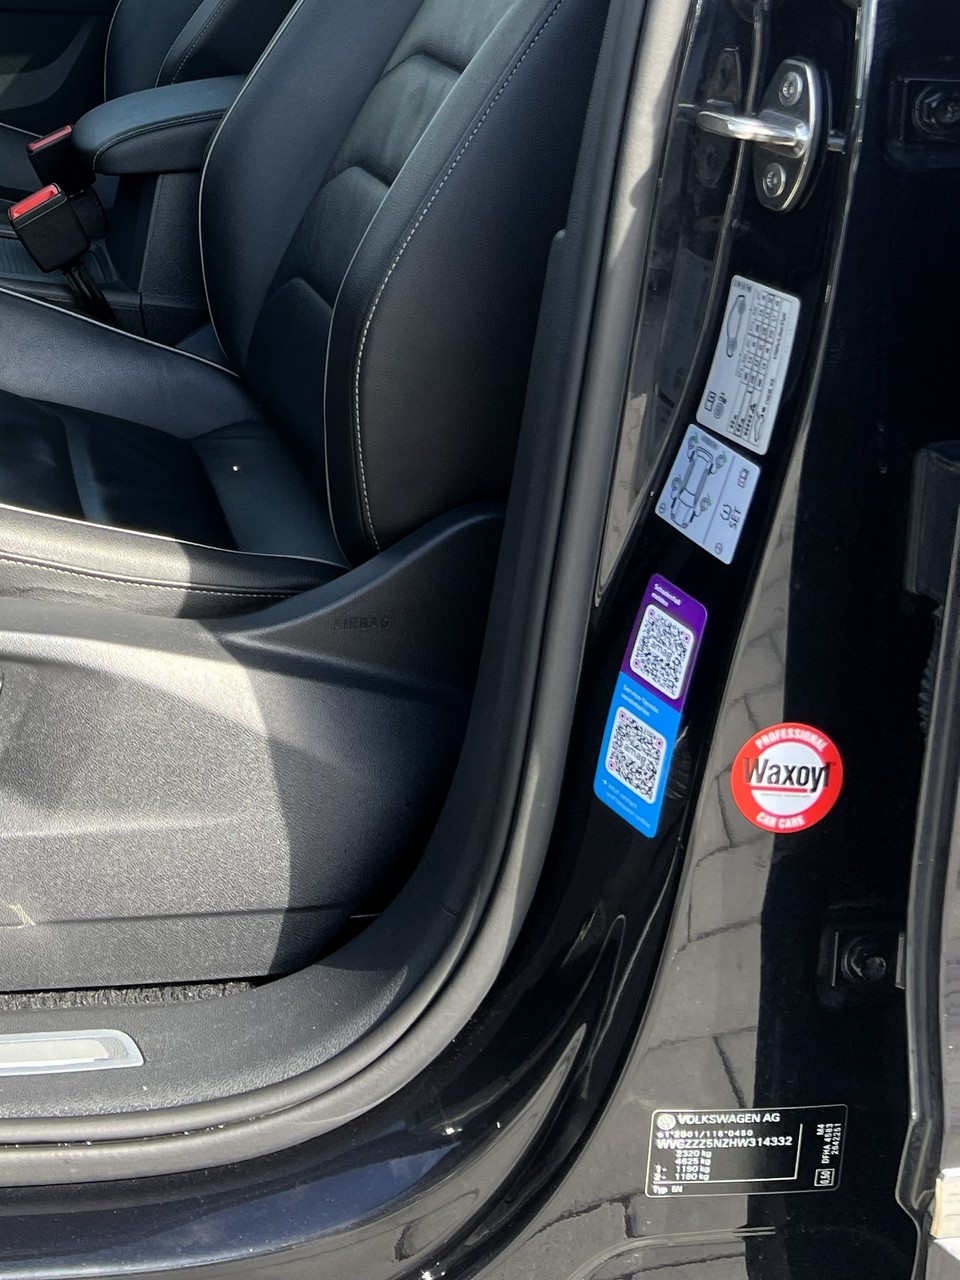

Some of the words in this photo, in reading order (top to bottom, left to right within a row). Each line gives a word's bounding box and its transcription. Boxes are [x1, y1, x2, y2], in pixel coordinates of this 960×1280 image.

[754, 727, 828, 753] PROFESSIONAL
[756, 811, 778, 828] CAR
[778, 815, 806, 829] CARE
[677, 1113, 760, 1125] VOLKSWAGEN
[762, 1112, 781, 1123] AG
[656, 1136, 793, 1149] WVGZZZ5NZHW314332
[701, 1150, 712, 1158] kg
[700, 1158, 711, 1166] kg
[699, 1165, 711, 1174] kg
[698, 1173, 710, 1181] kg
